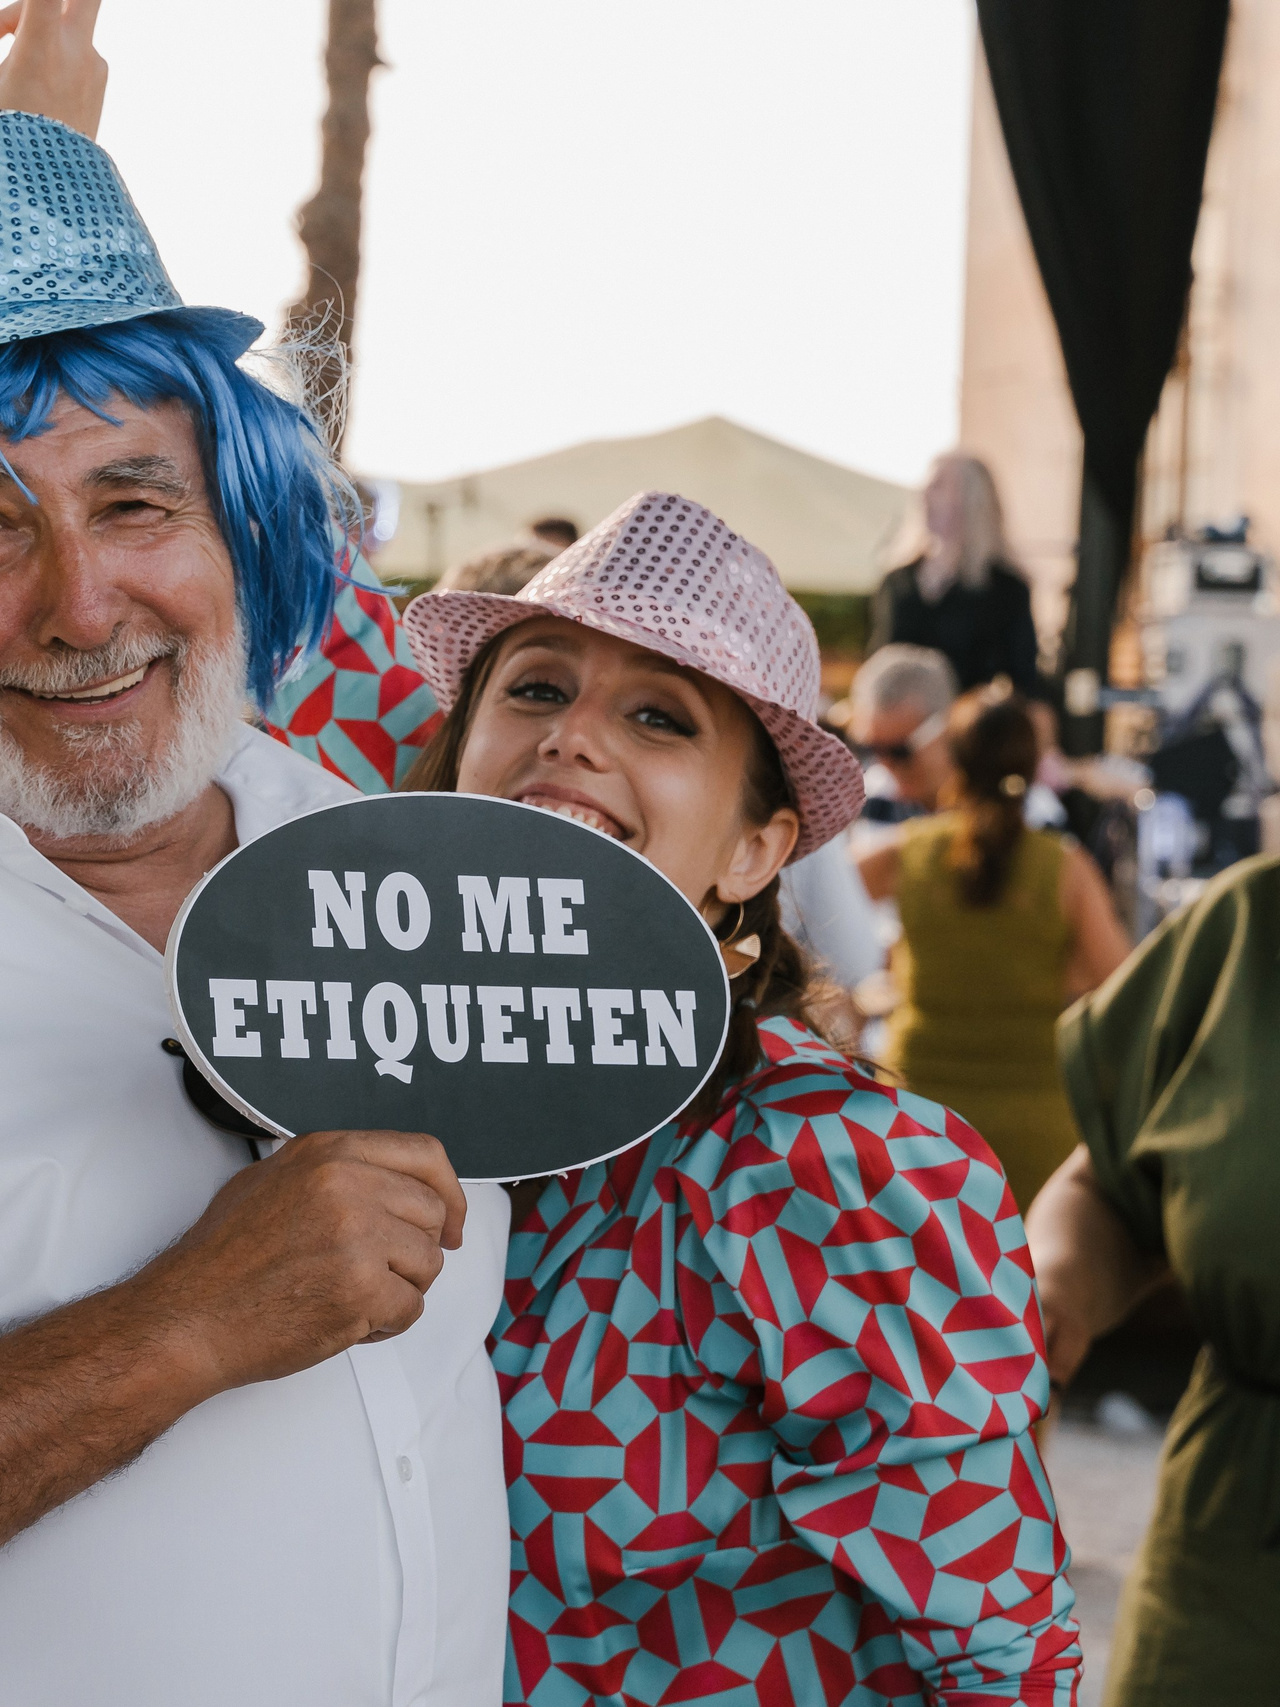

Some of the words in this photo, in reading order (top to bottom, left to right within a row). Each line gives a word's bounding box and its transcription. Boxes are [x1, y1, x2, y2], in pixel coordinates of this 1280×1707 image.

[308, 870, 430, 952] NO
[458, 875, 589, 955] ME
[209, 979, 698, 1083] ETIQUETEN
